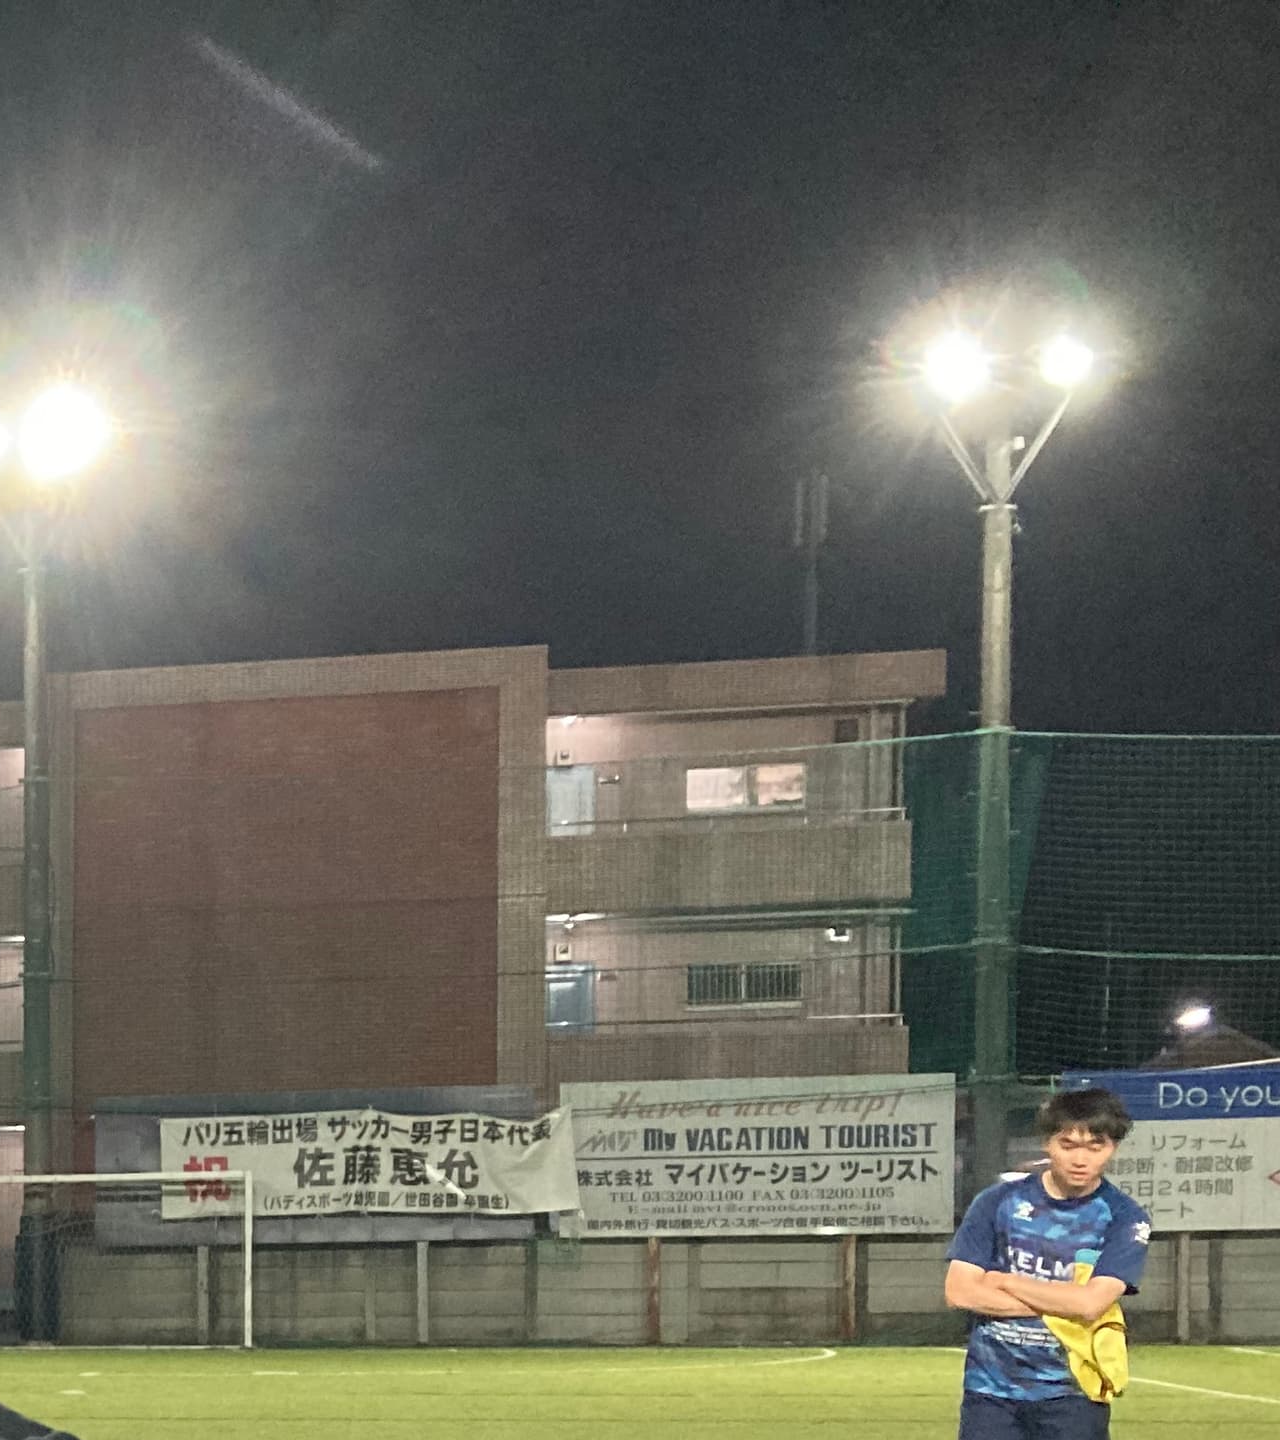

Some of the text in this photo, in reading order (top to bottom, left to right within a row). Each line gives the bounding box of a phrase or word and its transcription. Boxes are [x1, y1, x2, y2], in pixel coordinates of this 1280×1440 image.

[706, 1103, 721, 1118] a
[1158, 1081, 1280, 1112] Do you
[182, 1114, 552, 1147] パリ五輪出場 サッカー男子日本代表
[685, 1125, 809, 1151] VACATION
[819, 1122, 938, 1149] TOURIST
[293, 1144, 480, 1190] 佐藤恵允
[576, 1157, 939, 1188] 株式会社 マイバケーション ツーリスト
[609, 1190, 637, 1203] TEL
[752, 1188, 786, 1201] FAX
